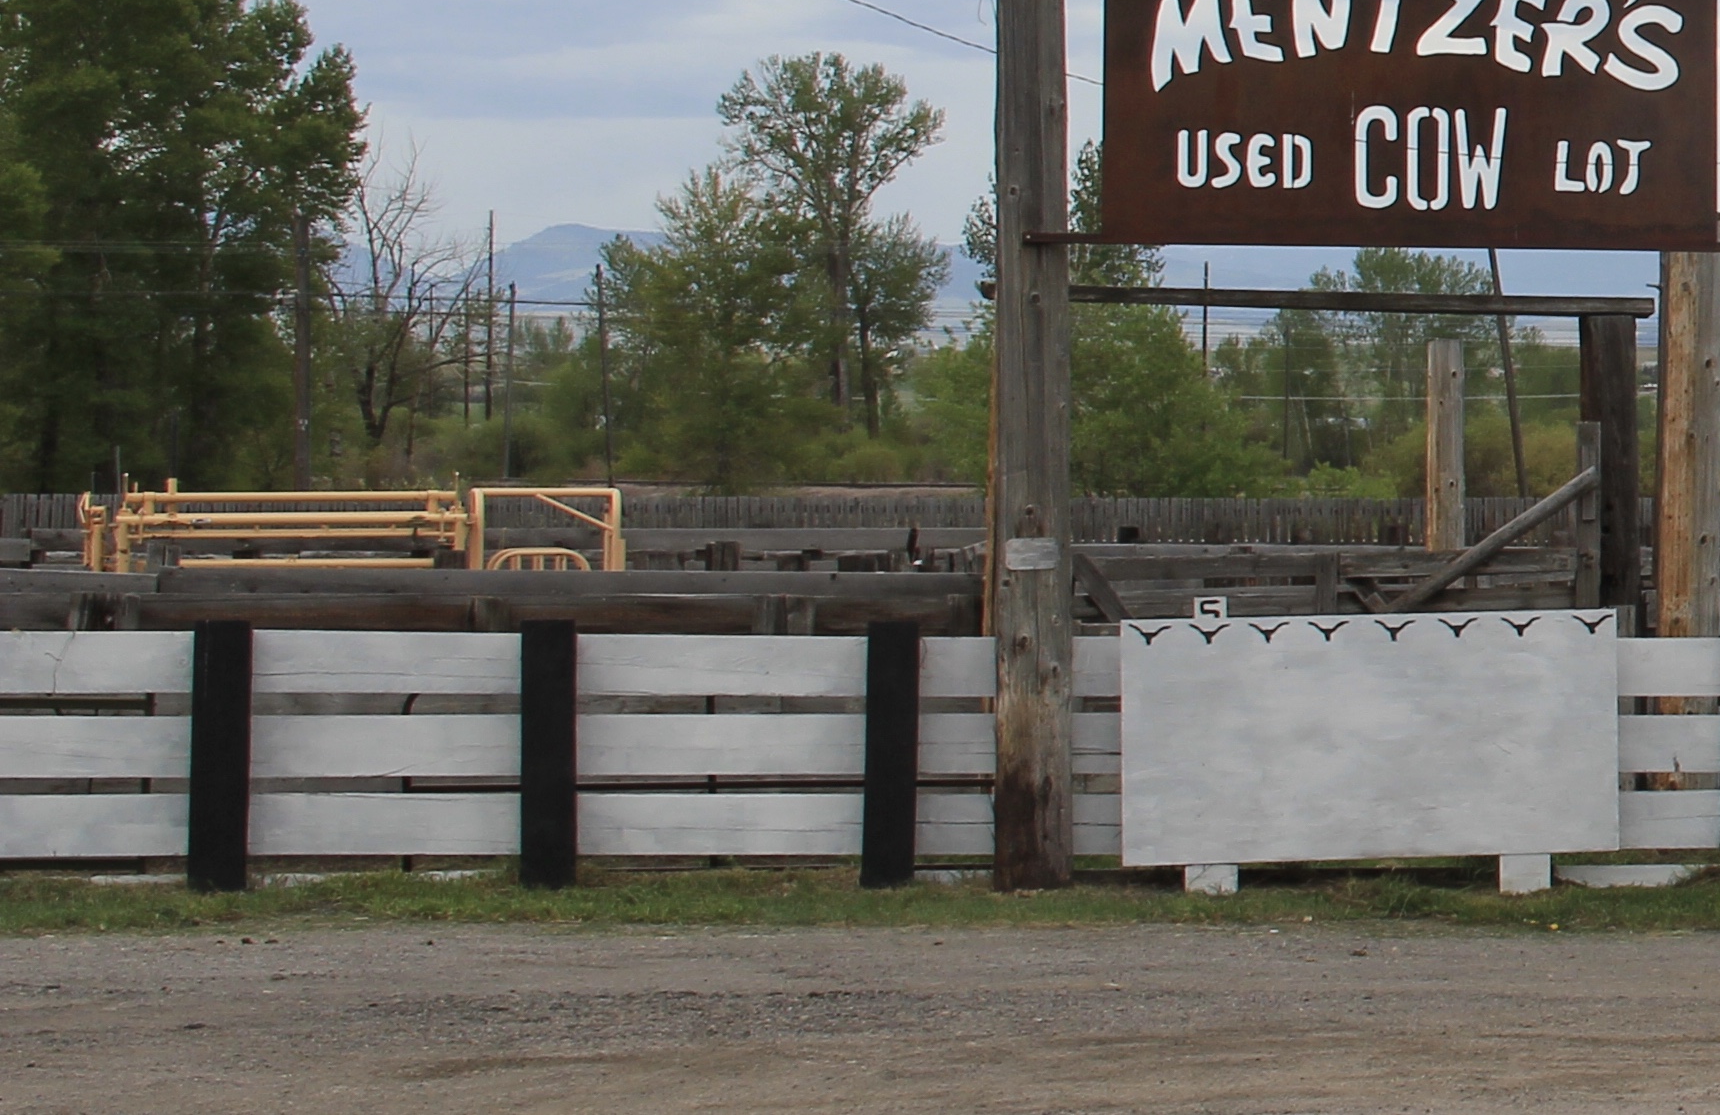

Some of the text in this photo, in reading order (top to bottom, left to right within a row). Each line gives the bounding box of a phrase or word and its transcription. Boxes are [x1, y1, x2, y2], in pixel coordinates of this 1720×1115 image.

[1177, 105, 1651, 210] USED COW LOT
